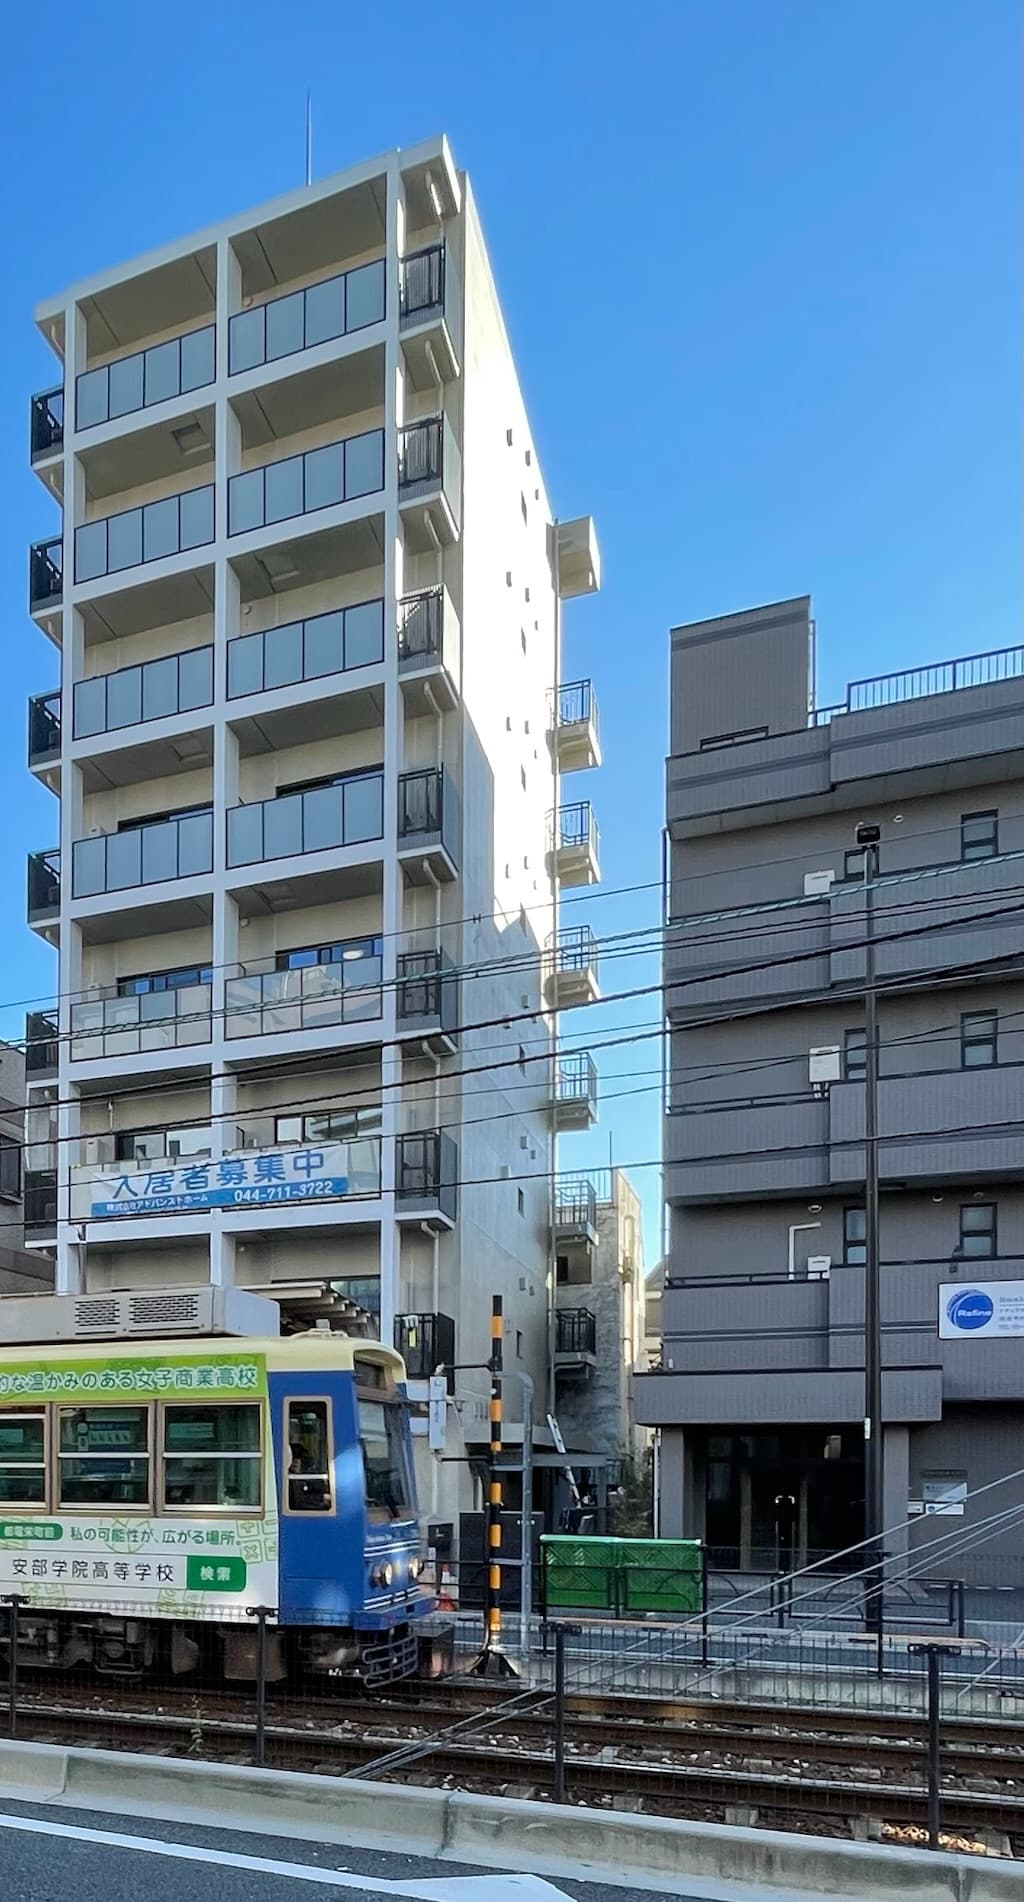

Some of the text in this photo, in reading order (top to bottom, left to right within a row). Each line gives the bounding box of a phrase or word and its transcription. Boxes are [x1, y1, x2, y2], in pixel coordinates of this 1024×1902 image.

[112, 1149, 324, 1199] 入居者募集中
[234, 1180, 333, 1202] 044-711-3722
[957, 1309, 992, 1317] Refine
[70, 1526, 241, 1546] 私の可能性が、広がる場所。
[12, 1559, 174, 1582] 安部学院高等学校
[199, 1565, 231, 1582] 検索
